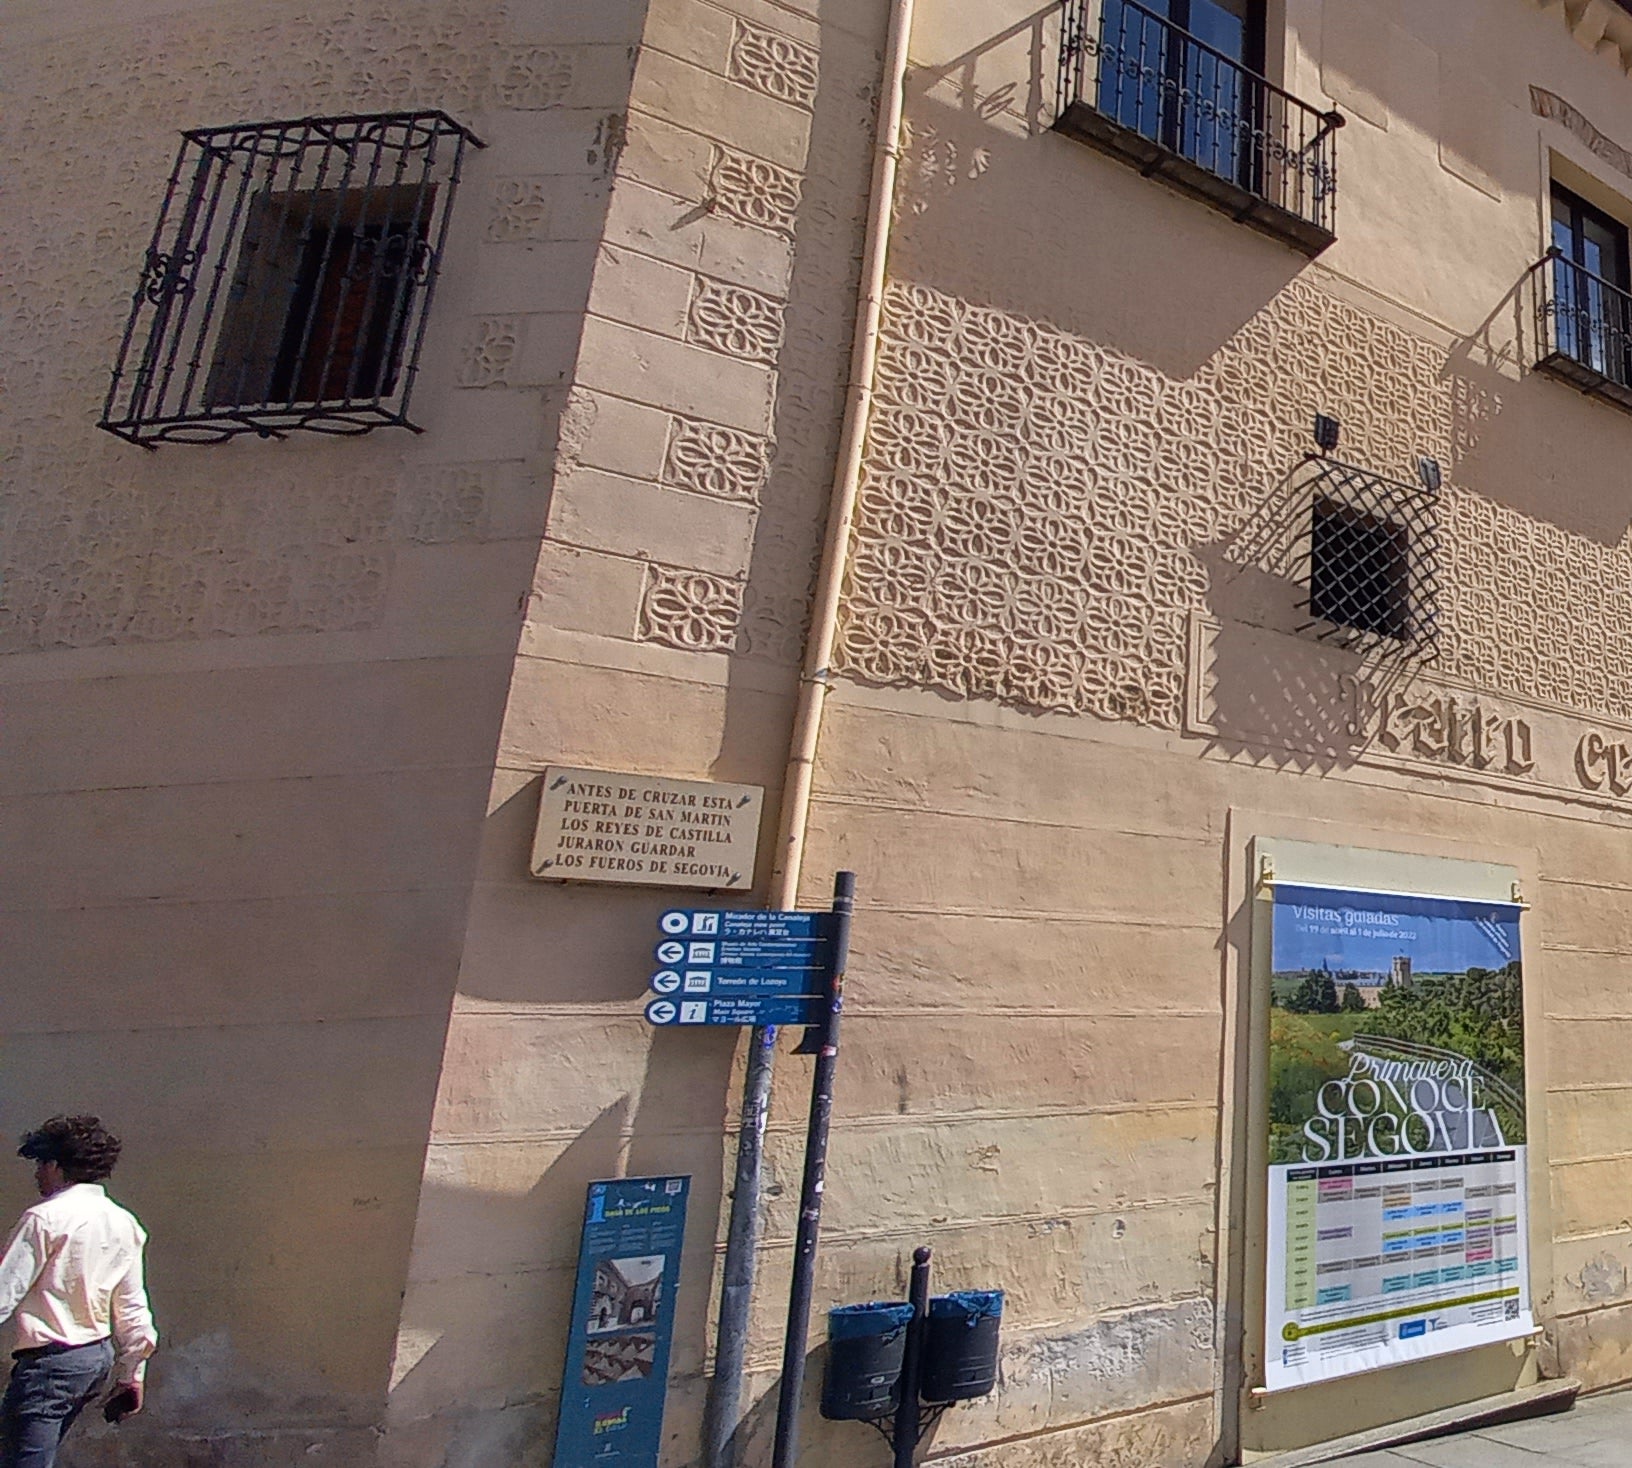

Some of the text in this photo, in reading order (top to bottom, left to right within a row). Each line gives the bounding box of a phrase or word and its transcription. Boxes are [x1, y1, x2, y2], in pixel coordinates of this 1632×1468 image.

[567, 784, 733, 810] ANTES DE CRUZAR ESTA
[564, 800, 731, 826] PUERTA DE SAN MARTIN
[561, 818, 732, 844] LOS REYES DE CASTILLA
[557, 836, 696, 858] JURARON GUARDAR
[555, 854, 730, 878] LOS FUEROS DE SEGOVIA
[724, 912, 756, 921] Mirador
[757, 913, 767, 921] de
[769, 913, 776, 921] la
[1292, 905, 1399, 926] Visitas guiadas
[749, 977, 759, 986] de
[713, 1000, 762, 1008] Plaza Mayor
[1344, 1052, 1473, 1084] Primavera
[1317, 1076, 1486, 1118] CONOCE
[1301, 1108, 1506, 1163] SEGOVIA
